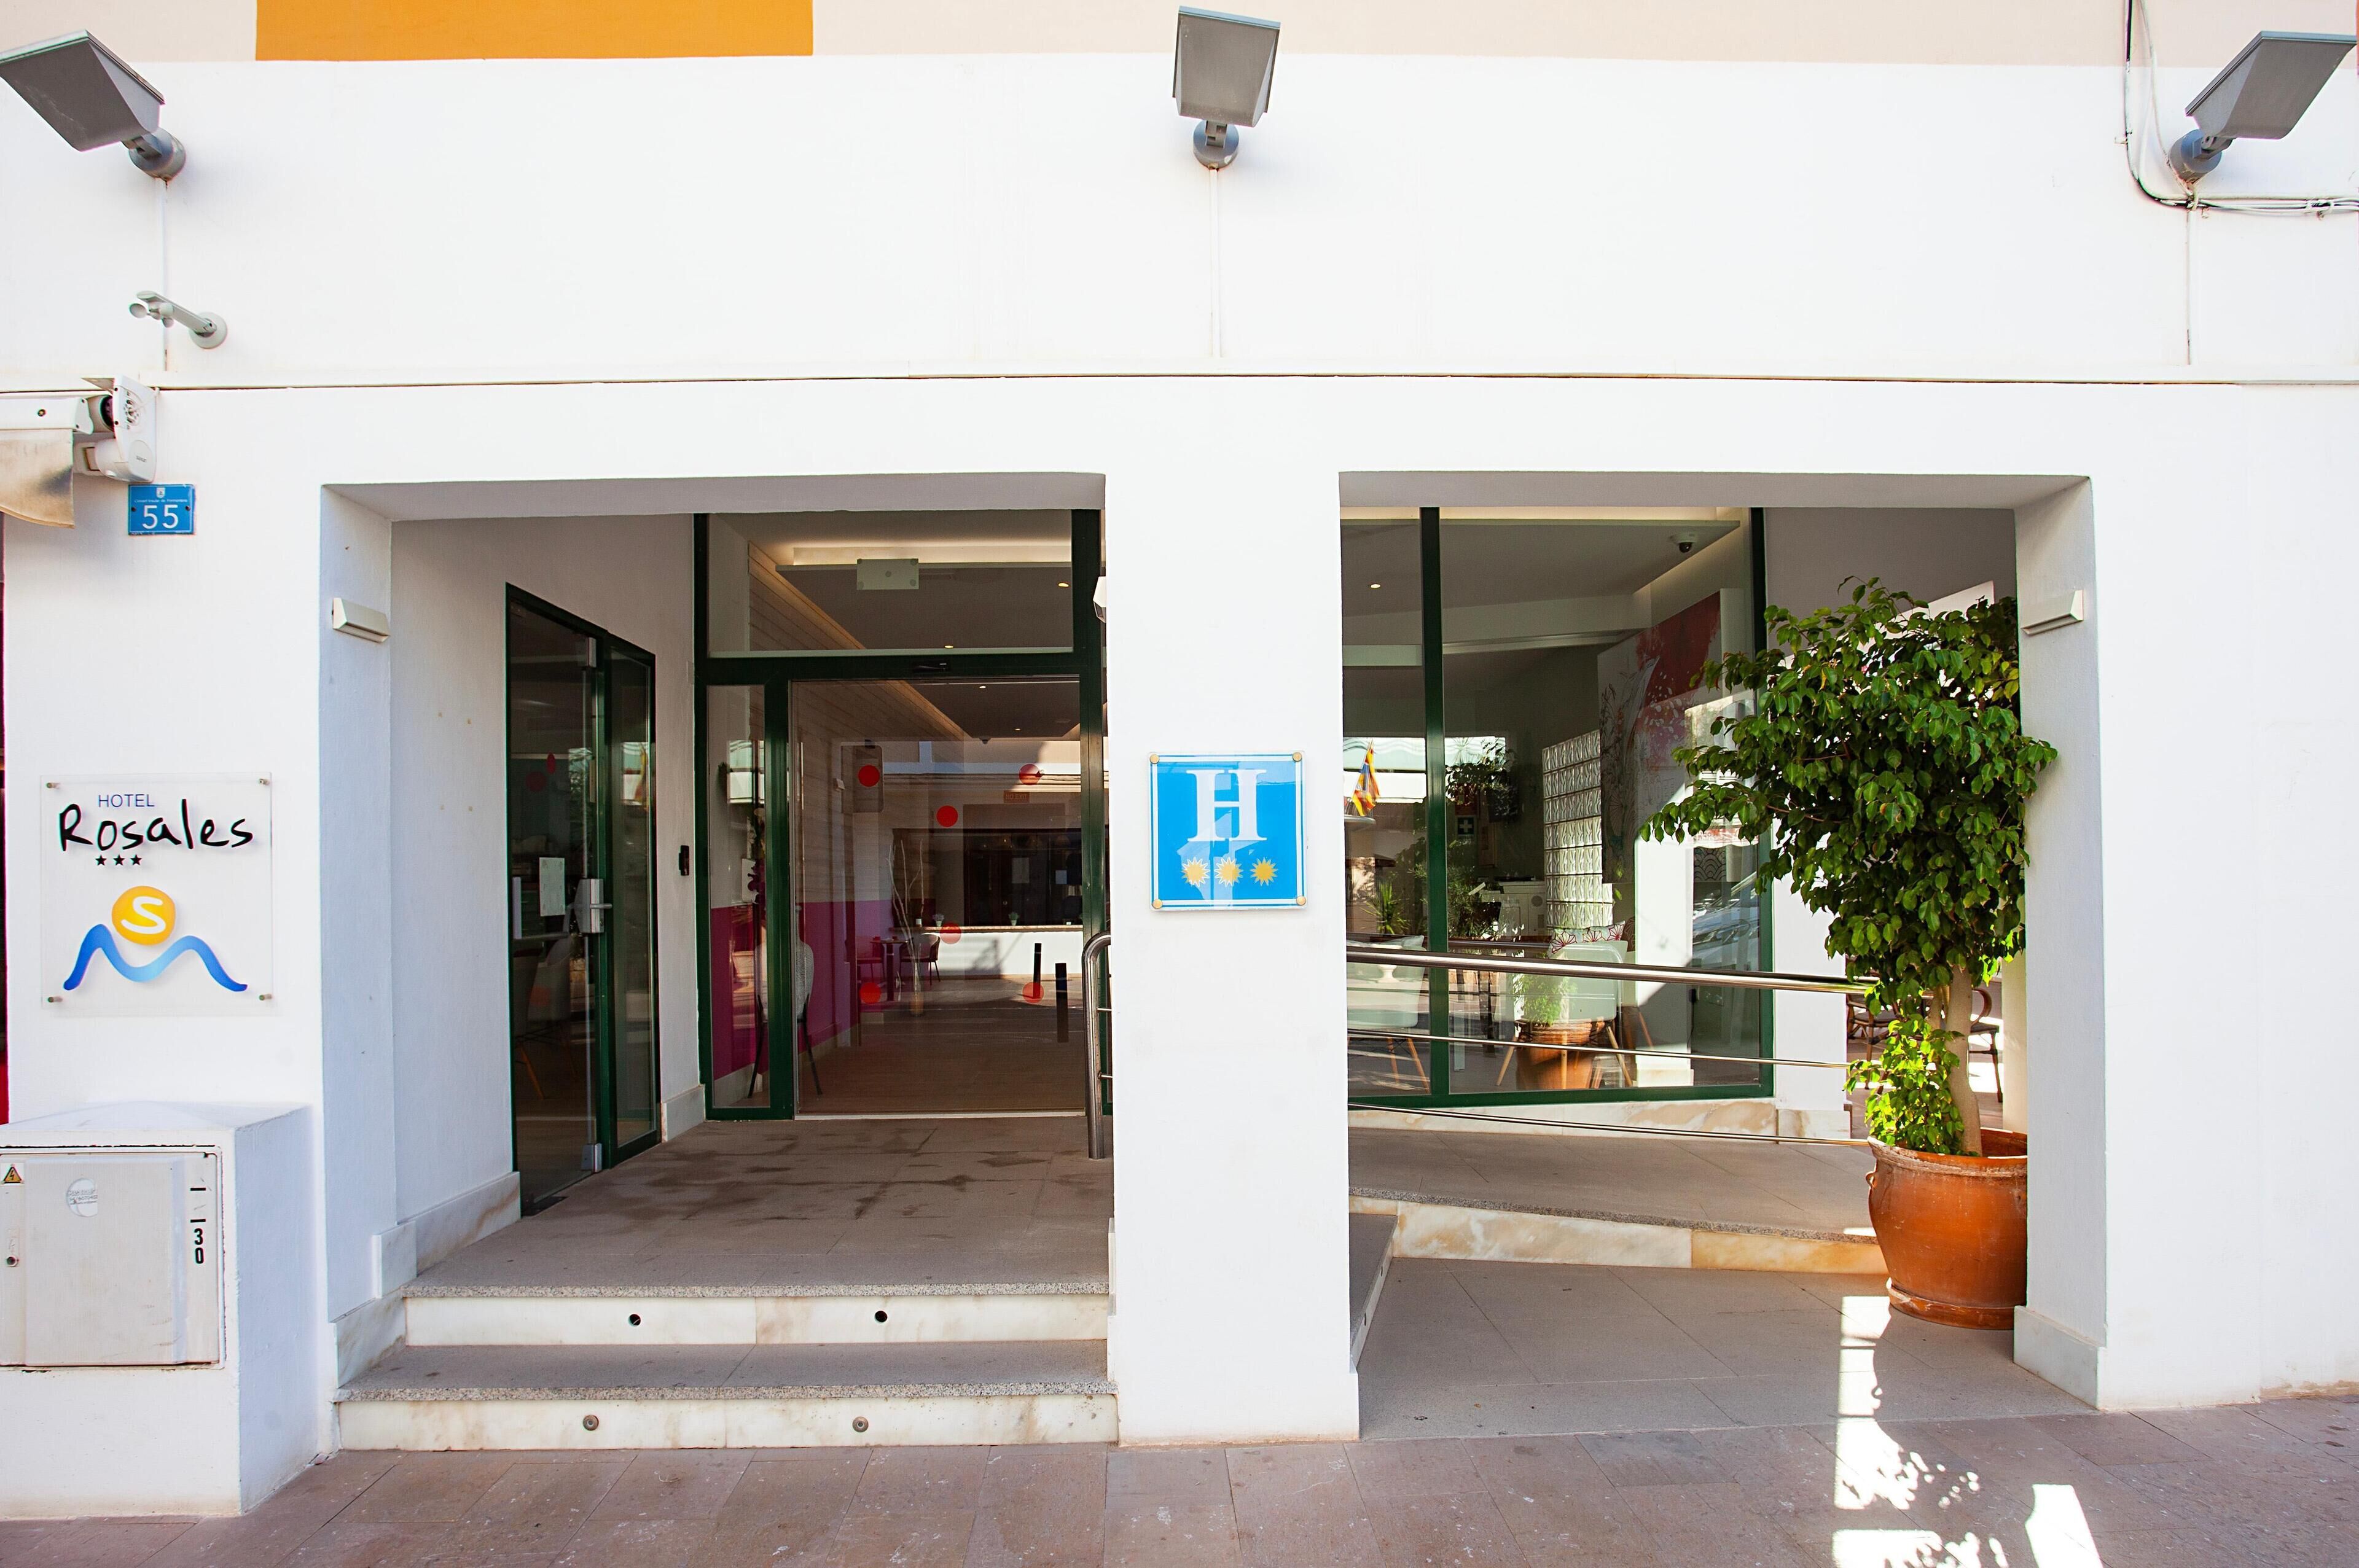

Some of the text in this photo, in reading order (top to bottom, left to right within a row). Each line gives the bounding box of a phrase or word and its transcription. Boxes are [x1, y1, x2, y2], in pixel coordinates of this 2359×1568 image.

[142, 504, 178, 529] 55
[98, 794, 155, 808] HOTEL
[1186, 770, 1267, 841] H
[59, 799, 254, 851] Rosales
